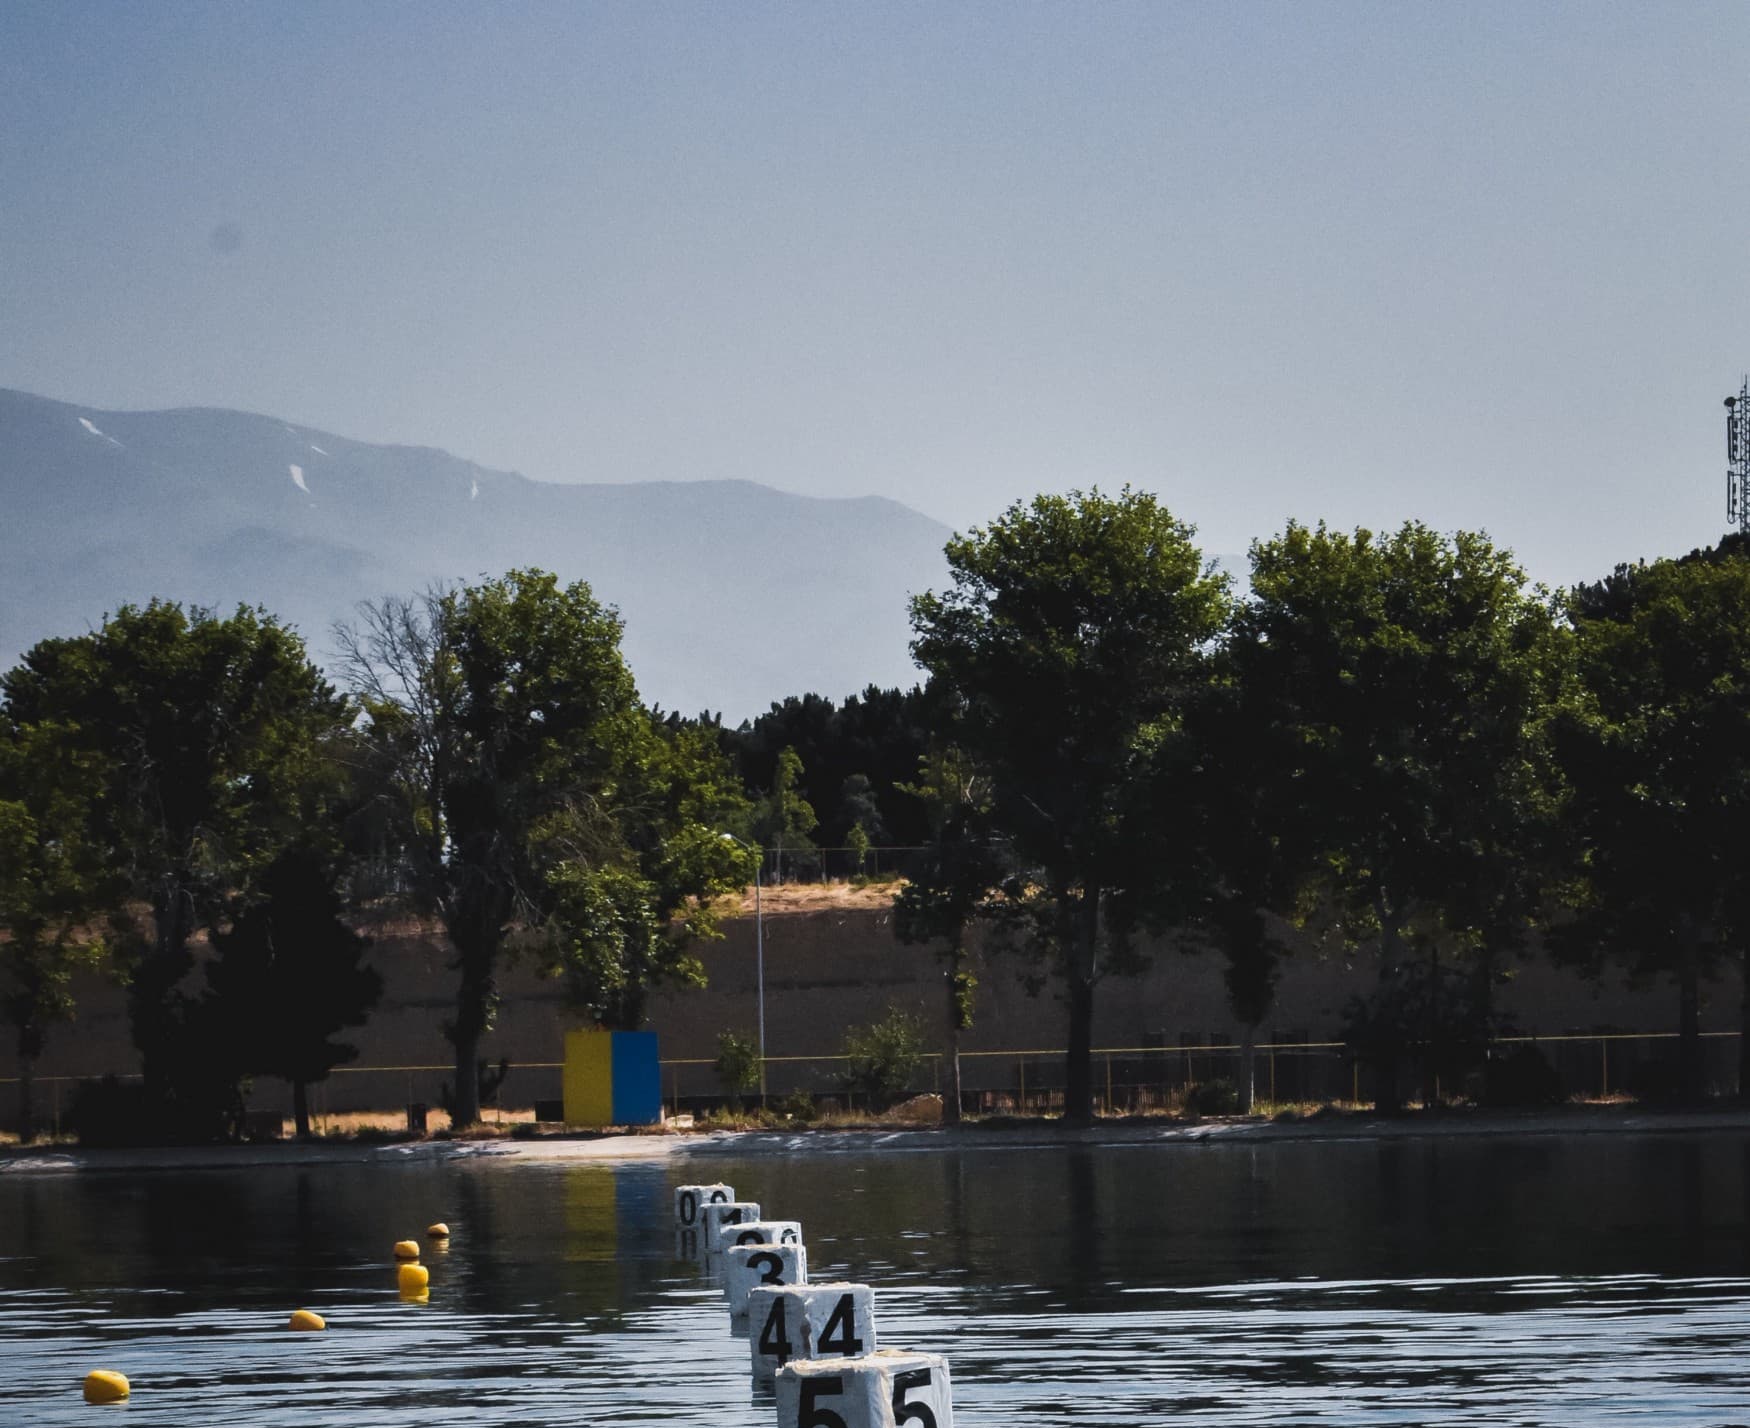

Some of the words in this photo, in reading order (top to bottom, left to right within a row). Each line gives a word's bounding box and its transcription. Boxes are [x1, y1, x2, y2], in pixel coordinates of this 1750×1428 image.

[746, 1251, 785, 1286] 3
[758, 1296, 792, 1368] 4
[817, 1293, 863, 1357] 4
